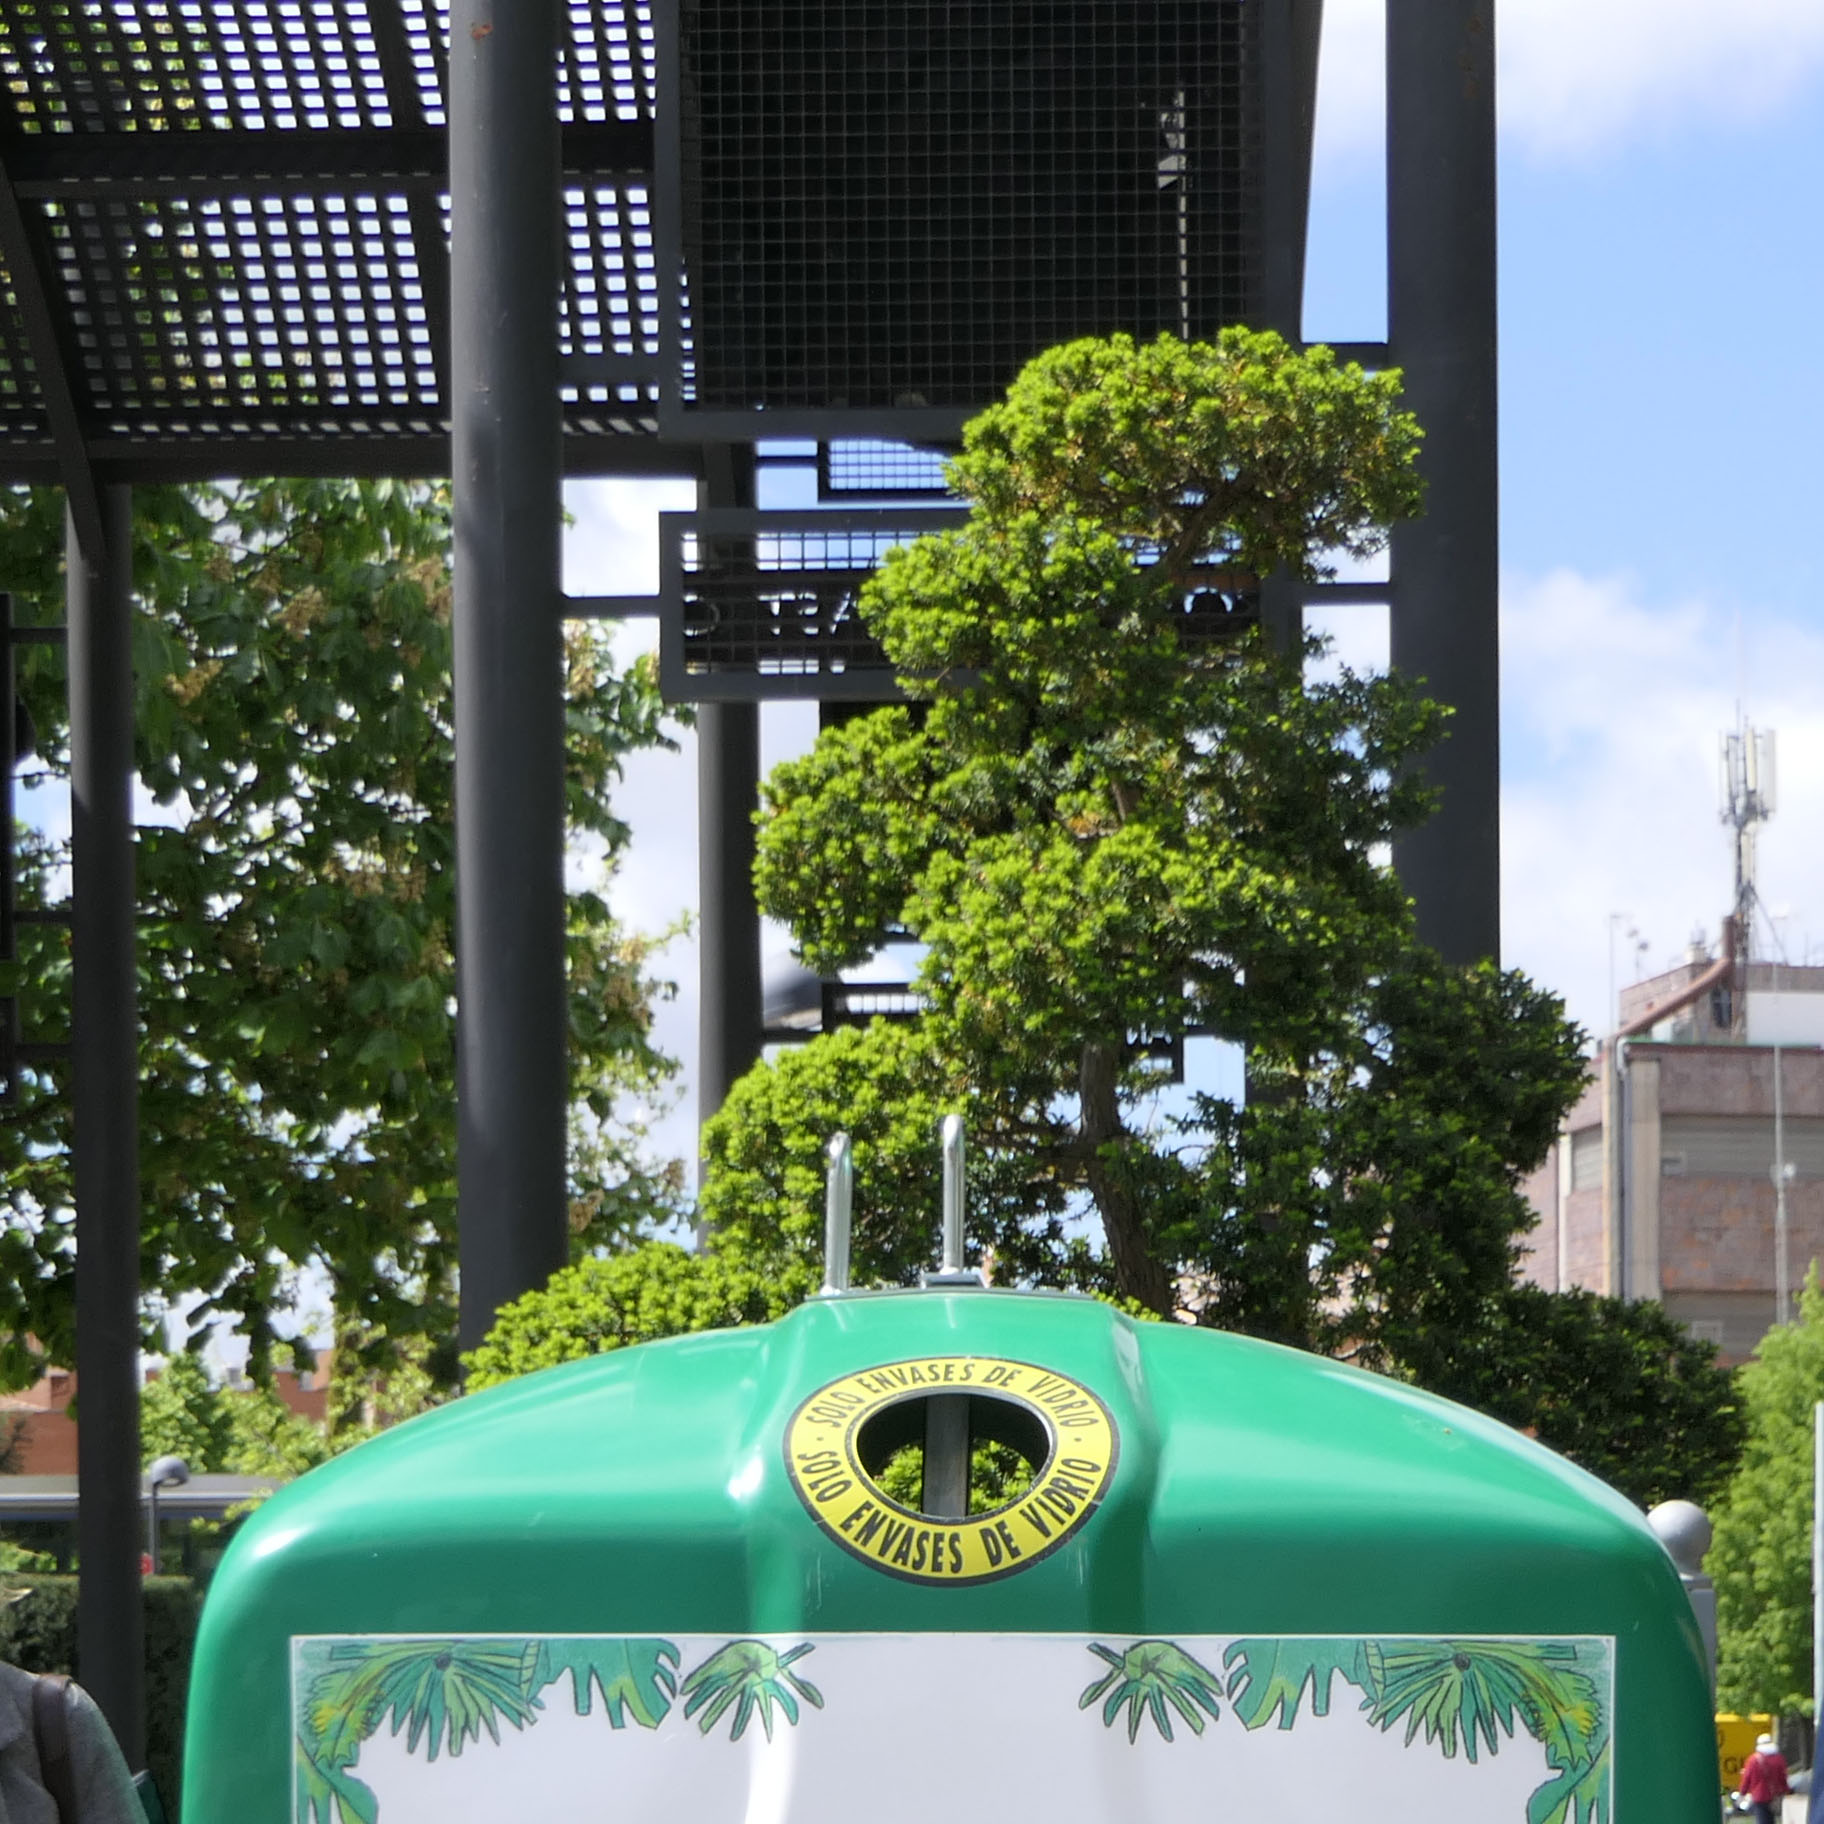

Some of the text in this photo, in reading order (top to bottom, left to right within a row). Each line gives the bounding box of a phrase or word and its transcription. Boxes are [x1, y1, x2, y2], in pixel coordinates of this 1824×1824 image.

[805, 1362, 1100, 1428] SOLO ENVASES DE VIDRIO
[797, 1450, 1103, 1574] SOLO ENVASES DE VIDRIO
